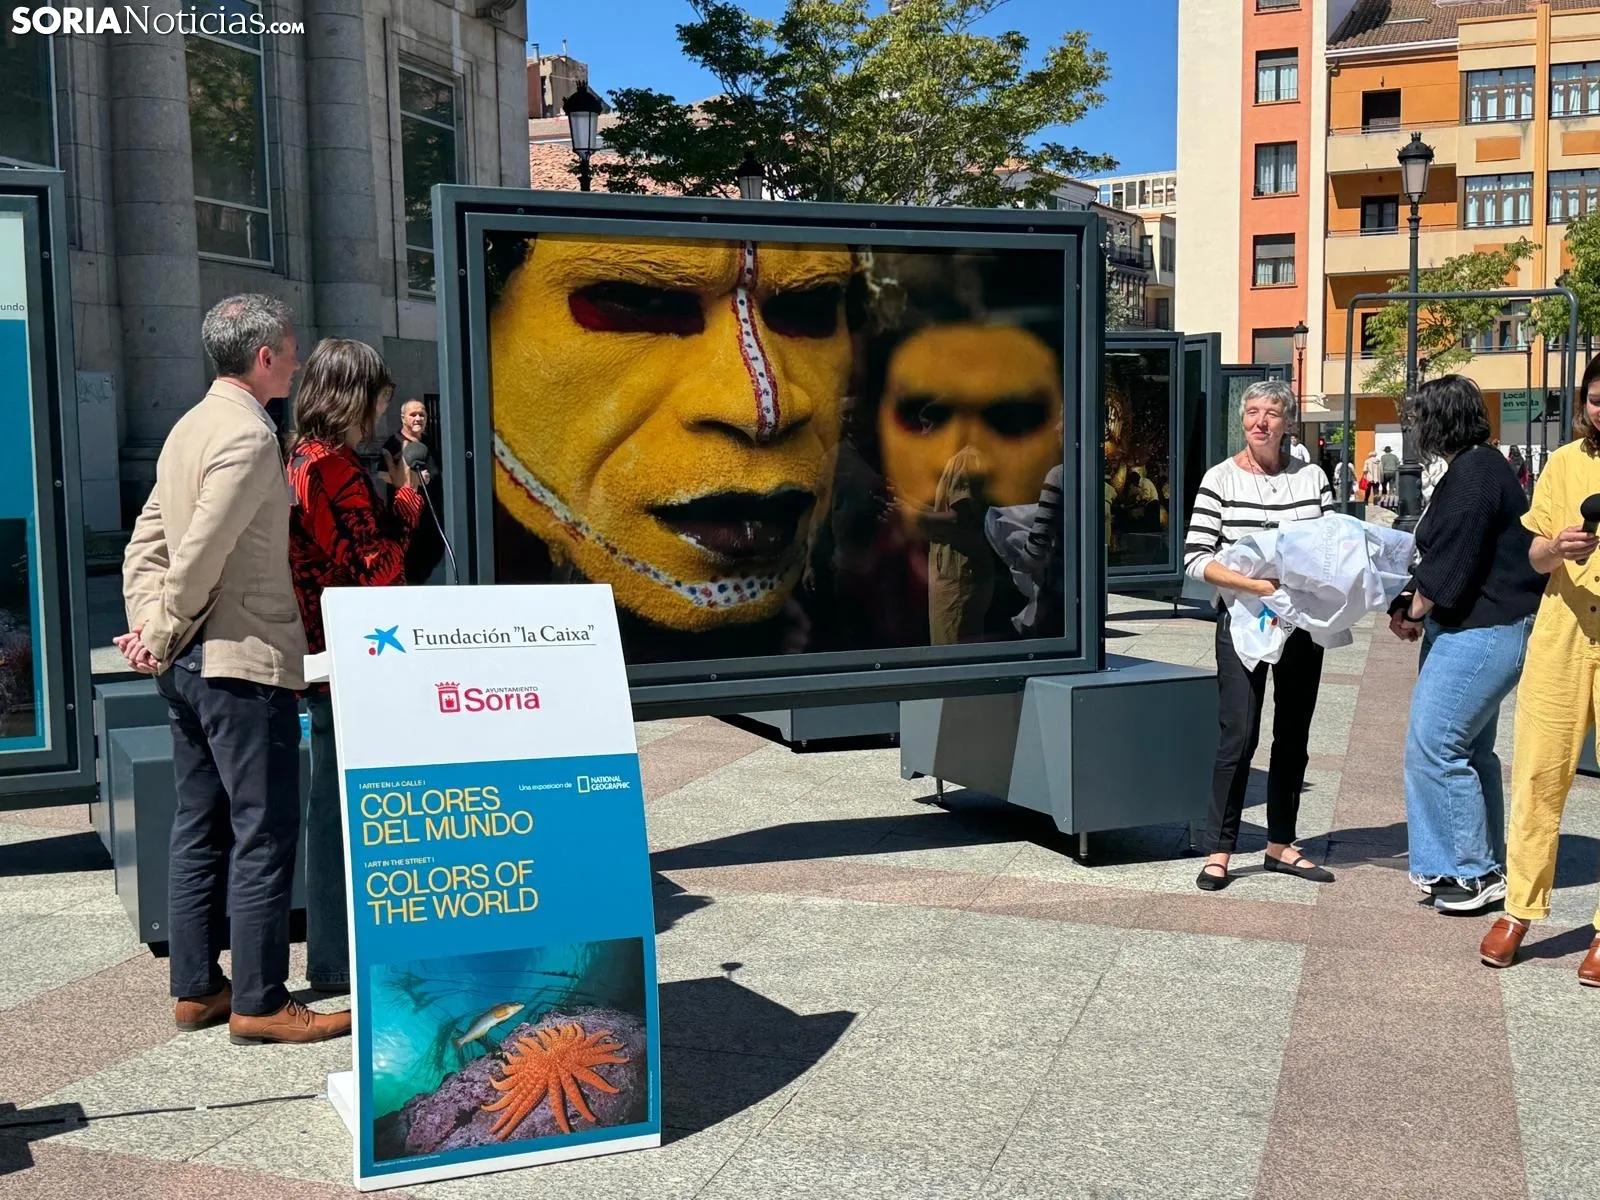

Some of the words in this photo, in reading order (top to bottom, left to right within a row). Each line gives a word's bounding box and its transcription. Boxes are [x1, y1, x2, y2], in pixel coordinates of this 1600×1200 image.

[0, 302, 25, 311] undo
[413, 628, 511, 646] Fundación
[464, 688, 541, 712] Soria
[485, 686, 539, 694] AYUNTAMIENTO
[591, 782, 630, 790] GEOGRAPHIC
[361, 786, 500, 818] COLORES
[362, 819, 420, 846] DEL
[426, 810, 534, 841] MUNDO
[368, 860, 382, 868] ART
[405, 857, 431, 865] STREET
[366, 864, 489, 898] COLORS
[495, 860, 534, 887] OF
[367, 897, 428, 925] THE
[432, 887, 539, 920] WORLD
